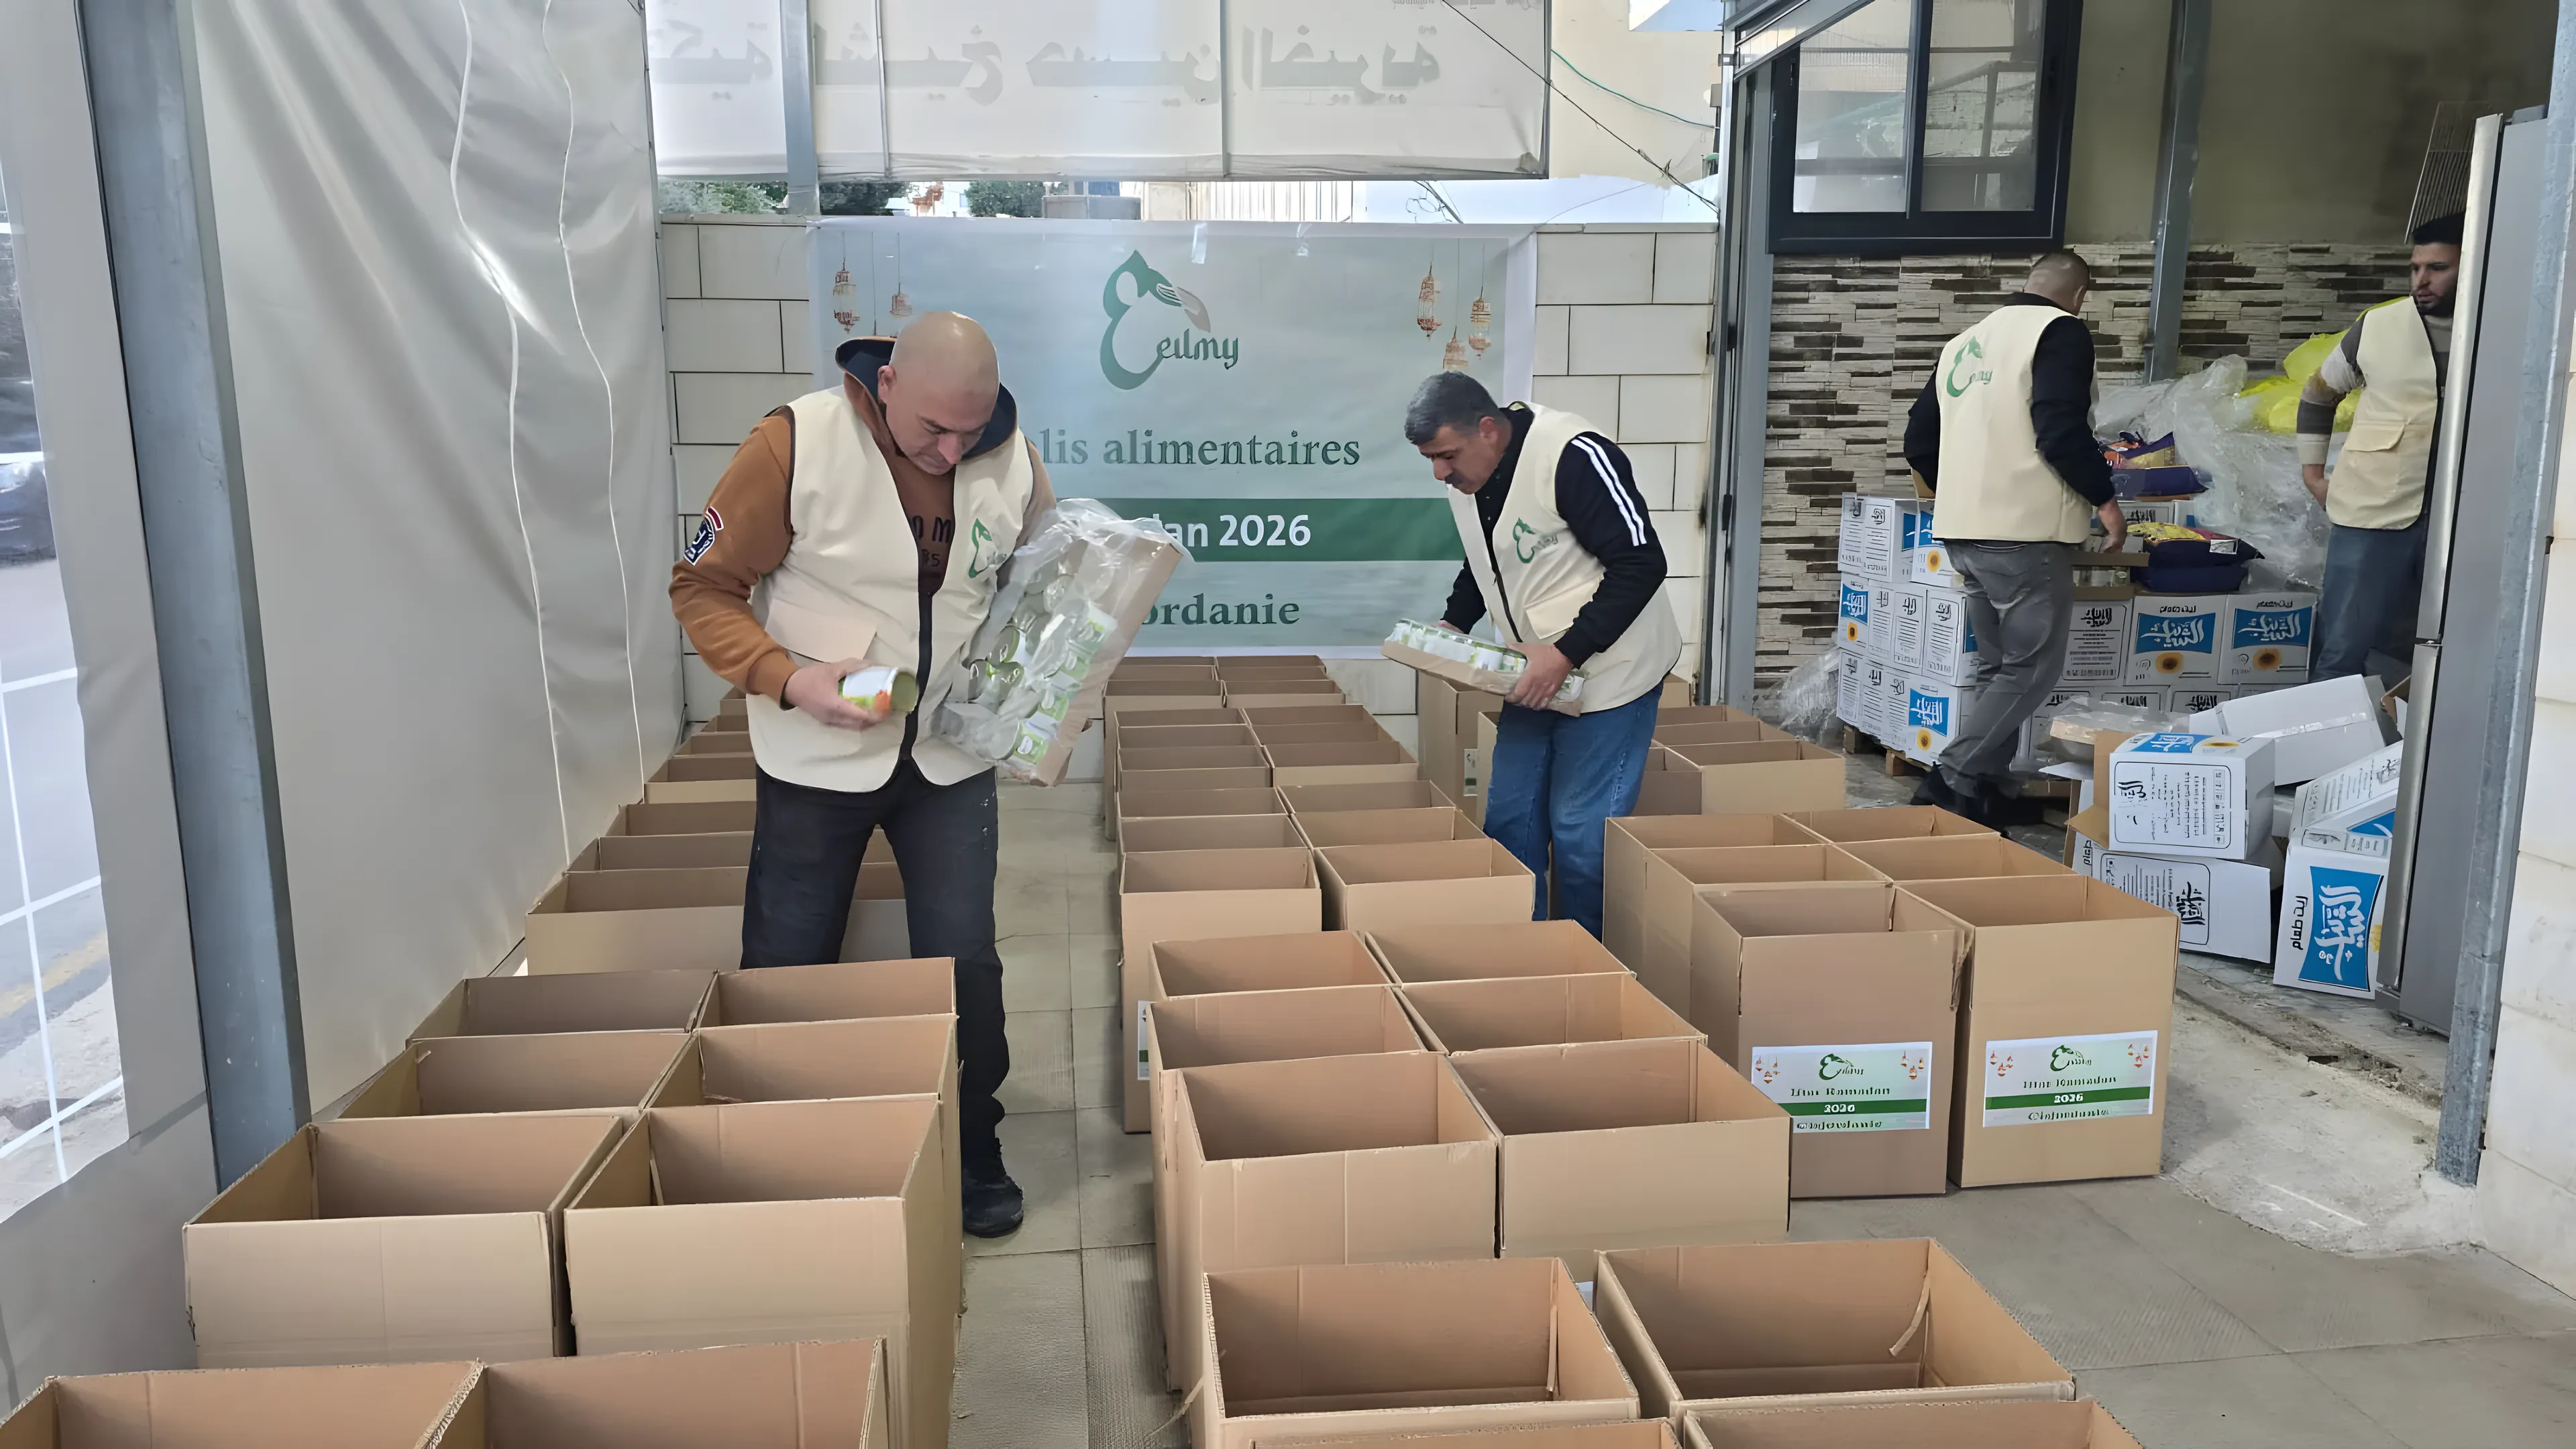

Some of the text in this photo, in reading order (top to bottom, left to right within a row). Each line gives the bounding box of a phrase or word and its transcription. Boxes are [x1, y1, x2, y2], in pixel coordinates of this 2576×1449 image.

[1039, 428, 1361, 466] lis alimentaires
[1219, 514, 1311, 547] 2026
[1142, 593, 1301, 626] ordanie
